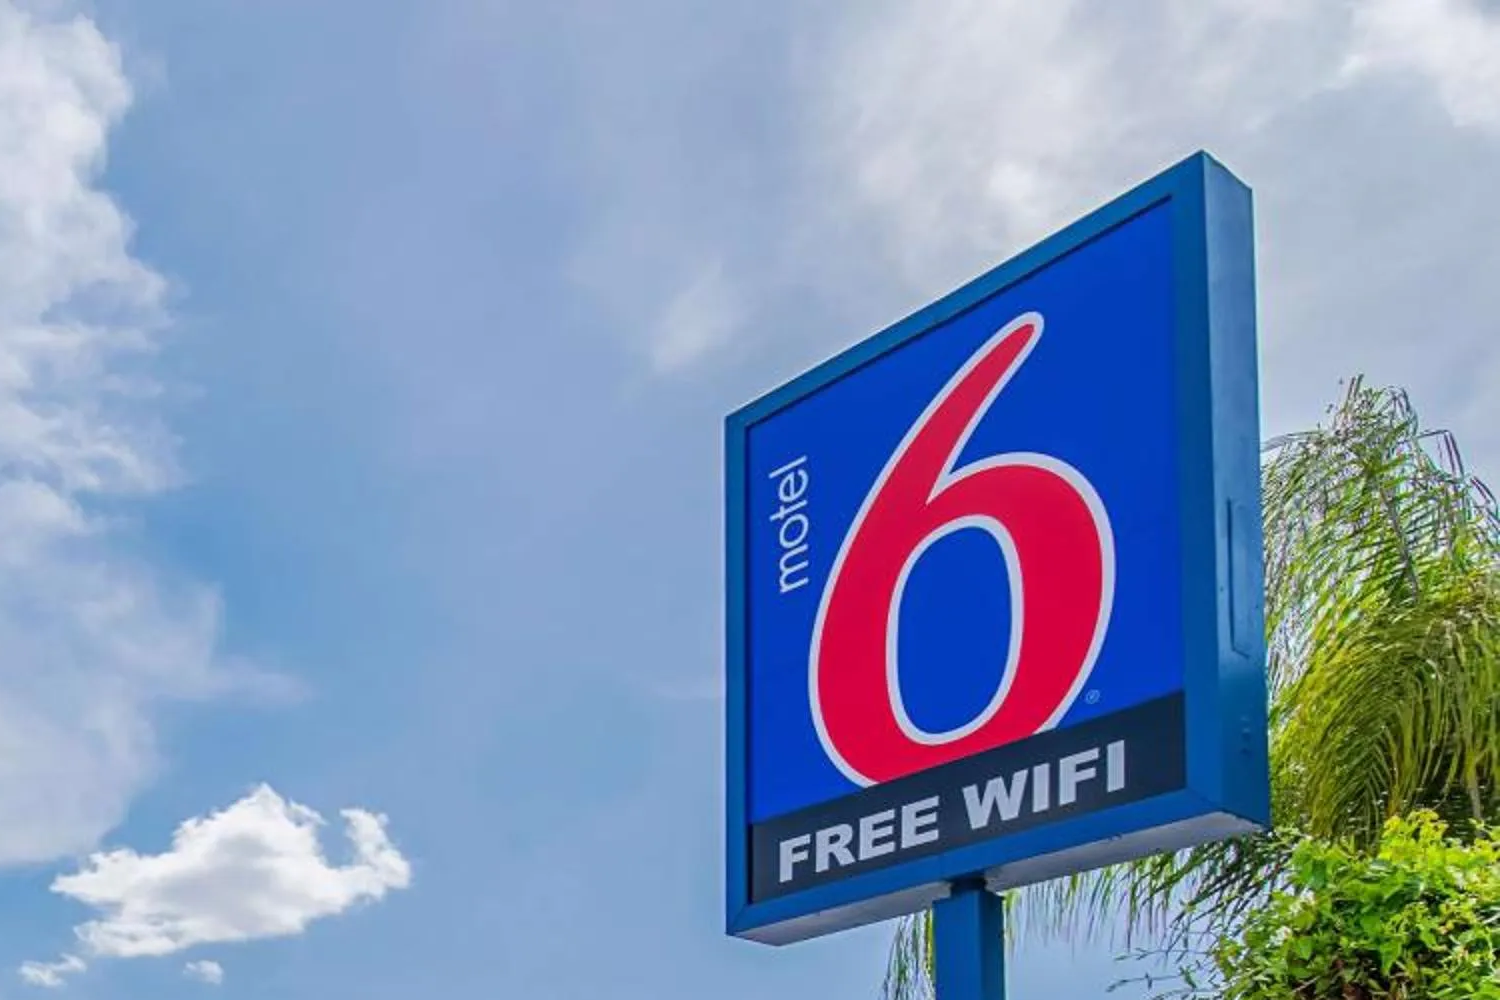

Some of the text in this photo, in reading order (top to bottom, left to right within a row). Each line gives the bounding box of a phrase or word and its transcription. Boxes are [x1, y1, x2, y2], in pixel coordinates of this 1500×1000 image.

[769, 454, 809, 595] motel
[808, 311, 1116, 788] 6
[779, 740, 1126, 884] FREE WIFI
